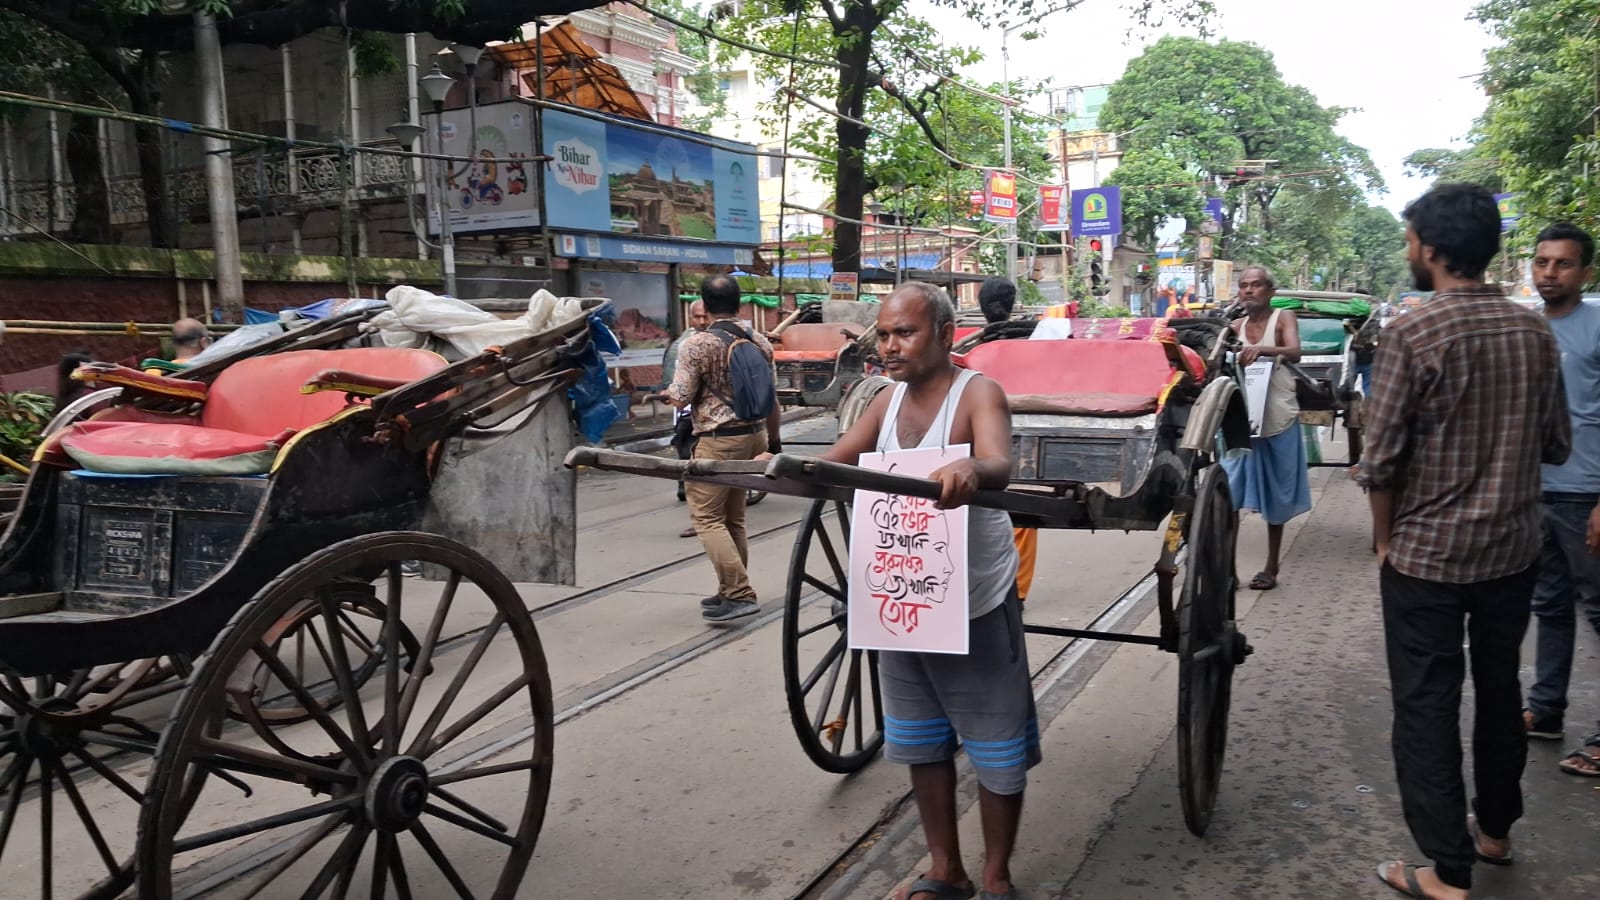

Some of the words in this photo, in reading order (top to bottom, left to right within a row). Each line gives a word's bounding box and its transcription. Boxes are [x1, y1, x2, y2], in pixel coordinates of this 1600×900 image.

[558, 145, 591, 166] Bihar
[566, 165, 598, 186] Nihar
[622, 243, 652, 255] BIDHAN
[900, 511, 936, 533] ভোর
[870, 593, 934, 636] তোর
